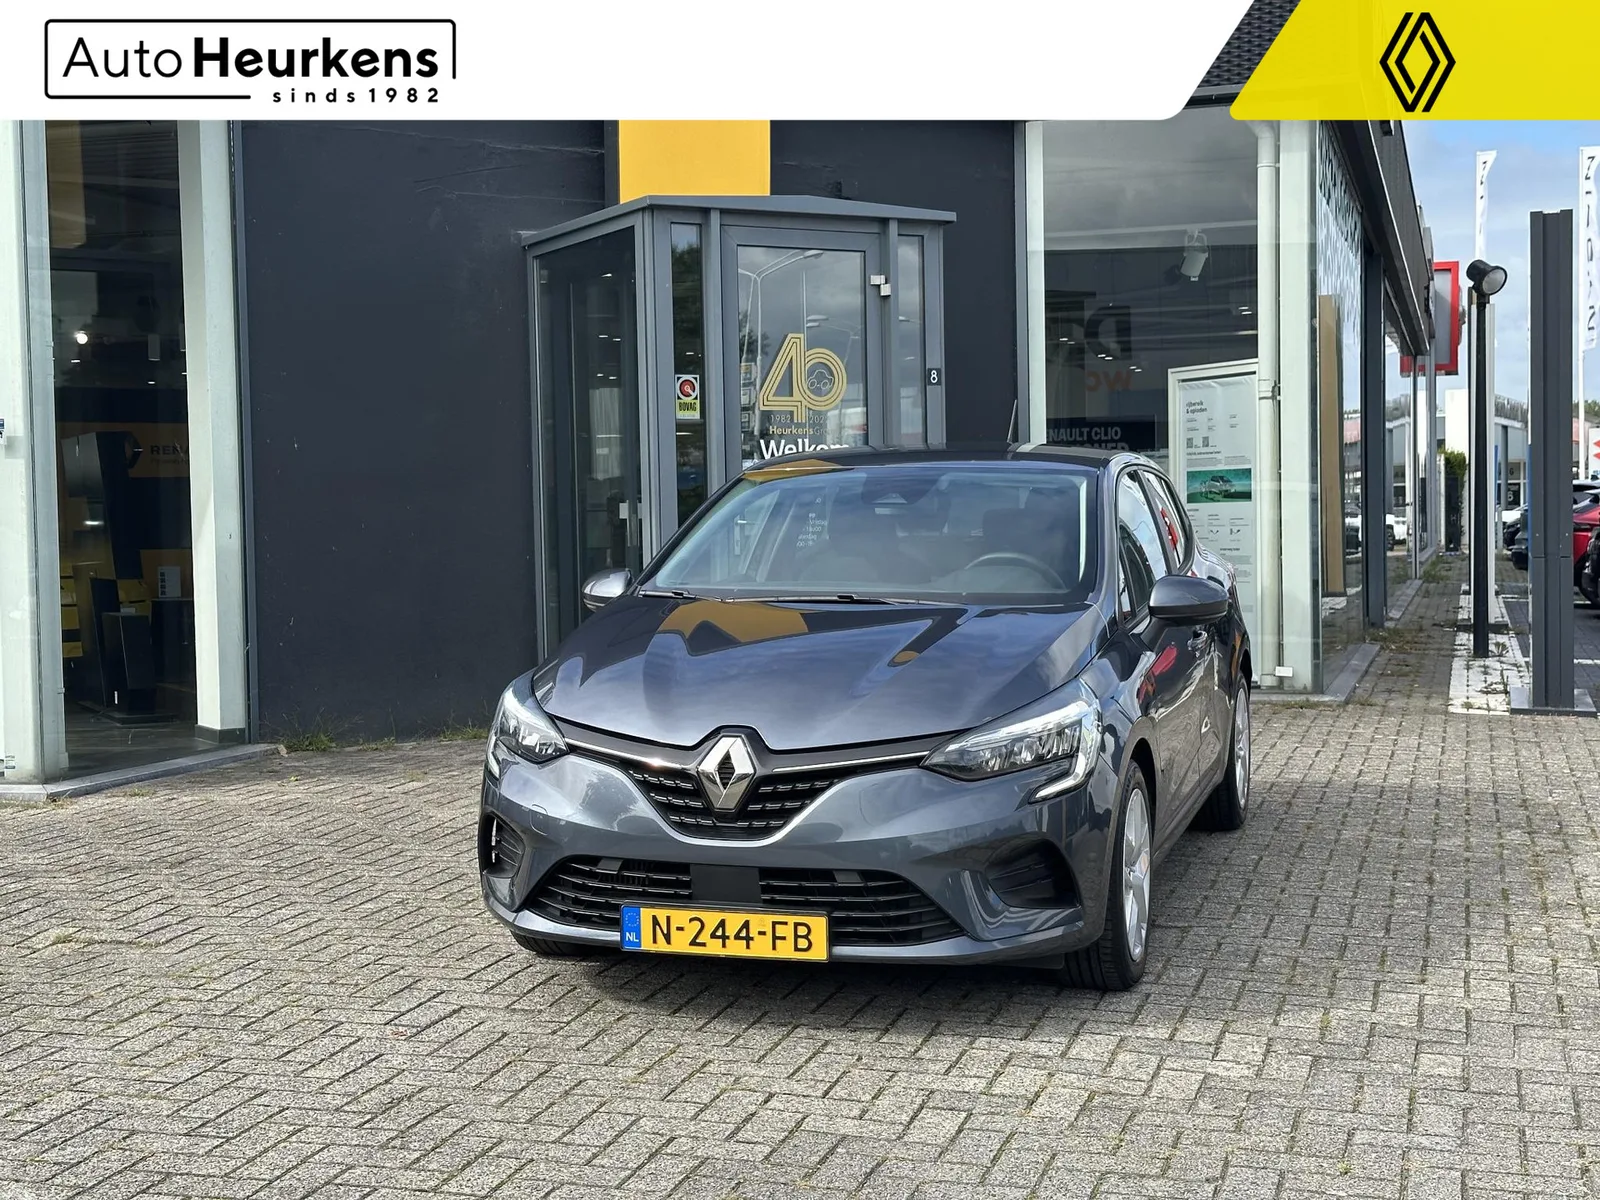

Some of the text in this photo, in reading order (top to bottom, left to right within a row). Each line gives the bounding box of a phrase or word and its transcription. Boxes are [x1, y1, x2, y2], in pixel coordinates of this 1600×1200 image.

[930, 371, 938, 383] 8
[679, 402, 697, 411] BOVAG
[770, 415, 791, 423] 1982
[1046, 426, 1122, 442] NAULT CLIO
[760, 438, 849, 460] Welk
[625, 914, 813, 953] NL N-244-FB
